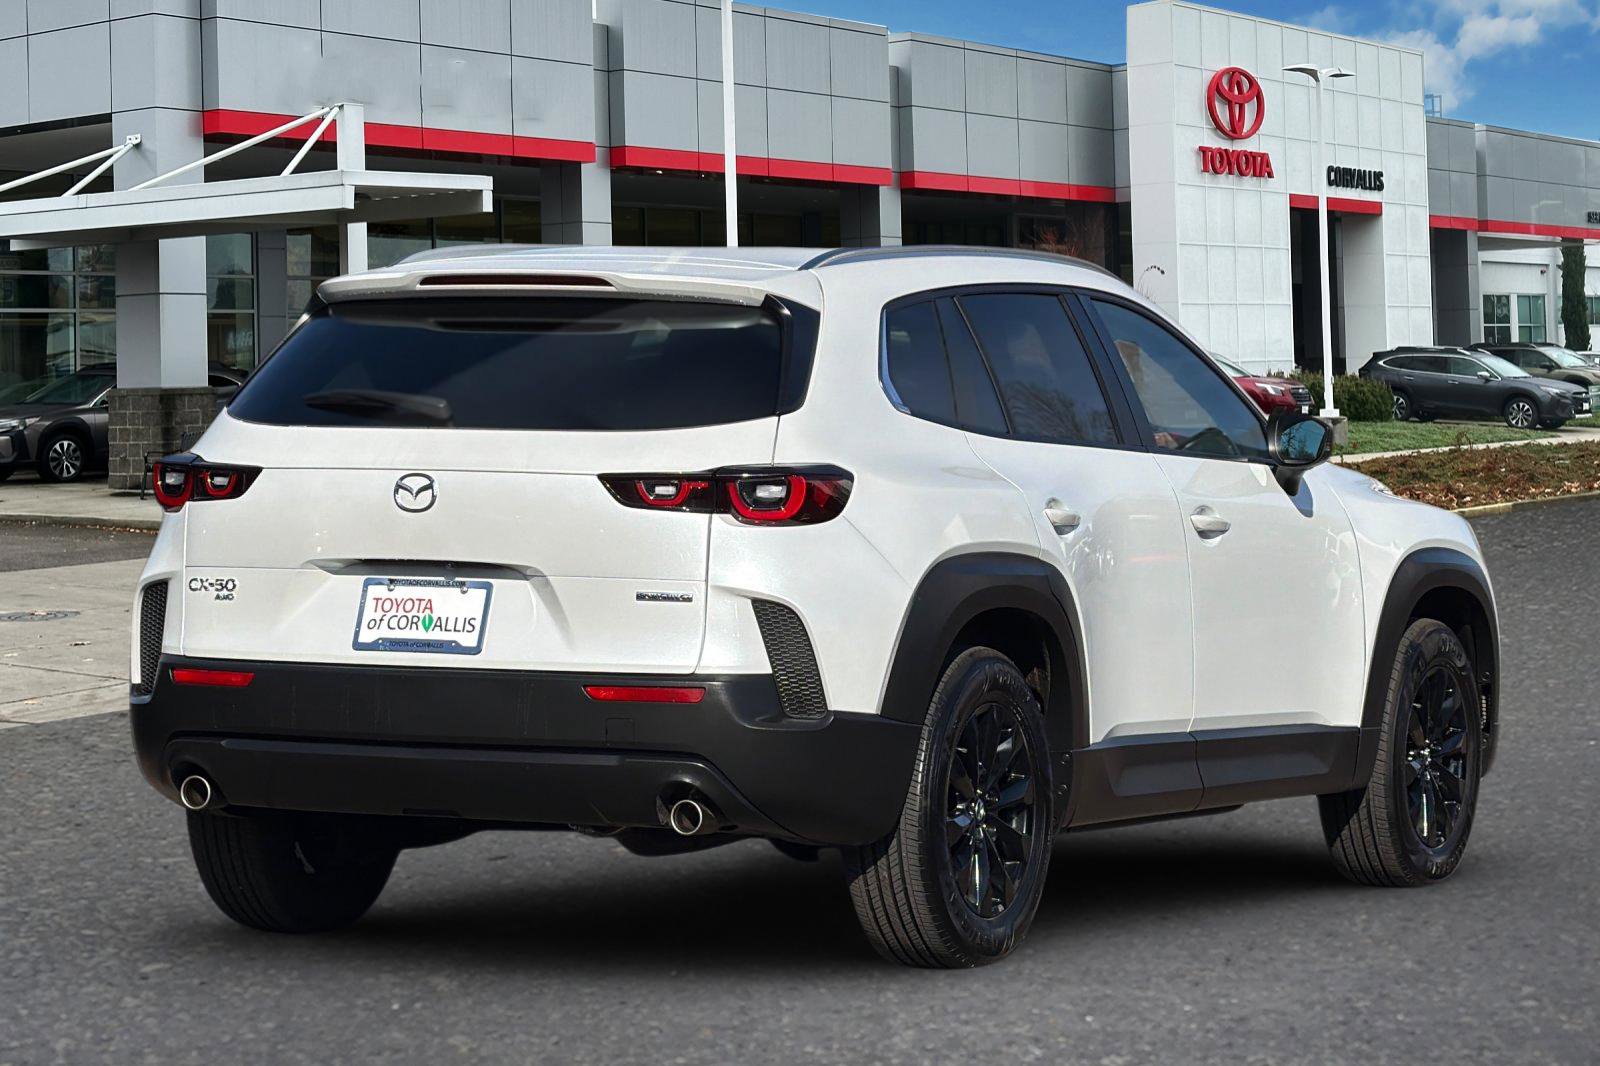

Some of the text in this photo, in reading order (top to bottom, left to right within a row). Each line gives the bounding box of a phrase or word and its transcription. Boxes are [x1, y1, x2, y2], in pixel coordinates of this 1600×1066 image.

[1199, 146, 1275, 178] TOYOTA
[1327, 165, 1385, 191] CORVALLIS
[188, 577, 237, 592] CX-50
[373, 597, 434, 614] TOYOTA
[367, 614, 387, 630] of
